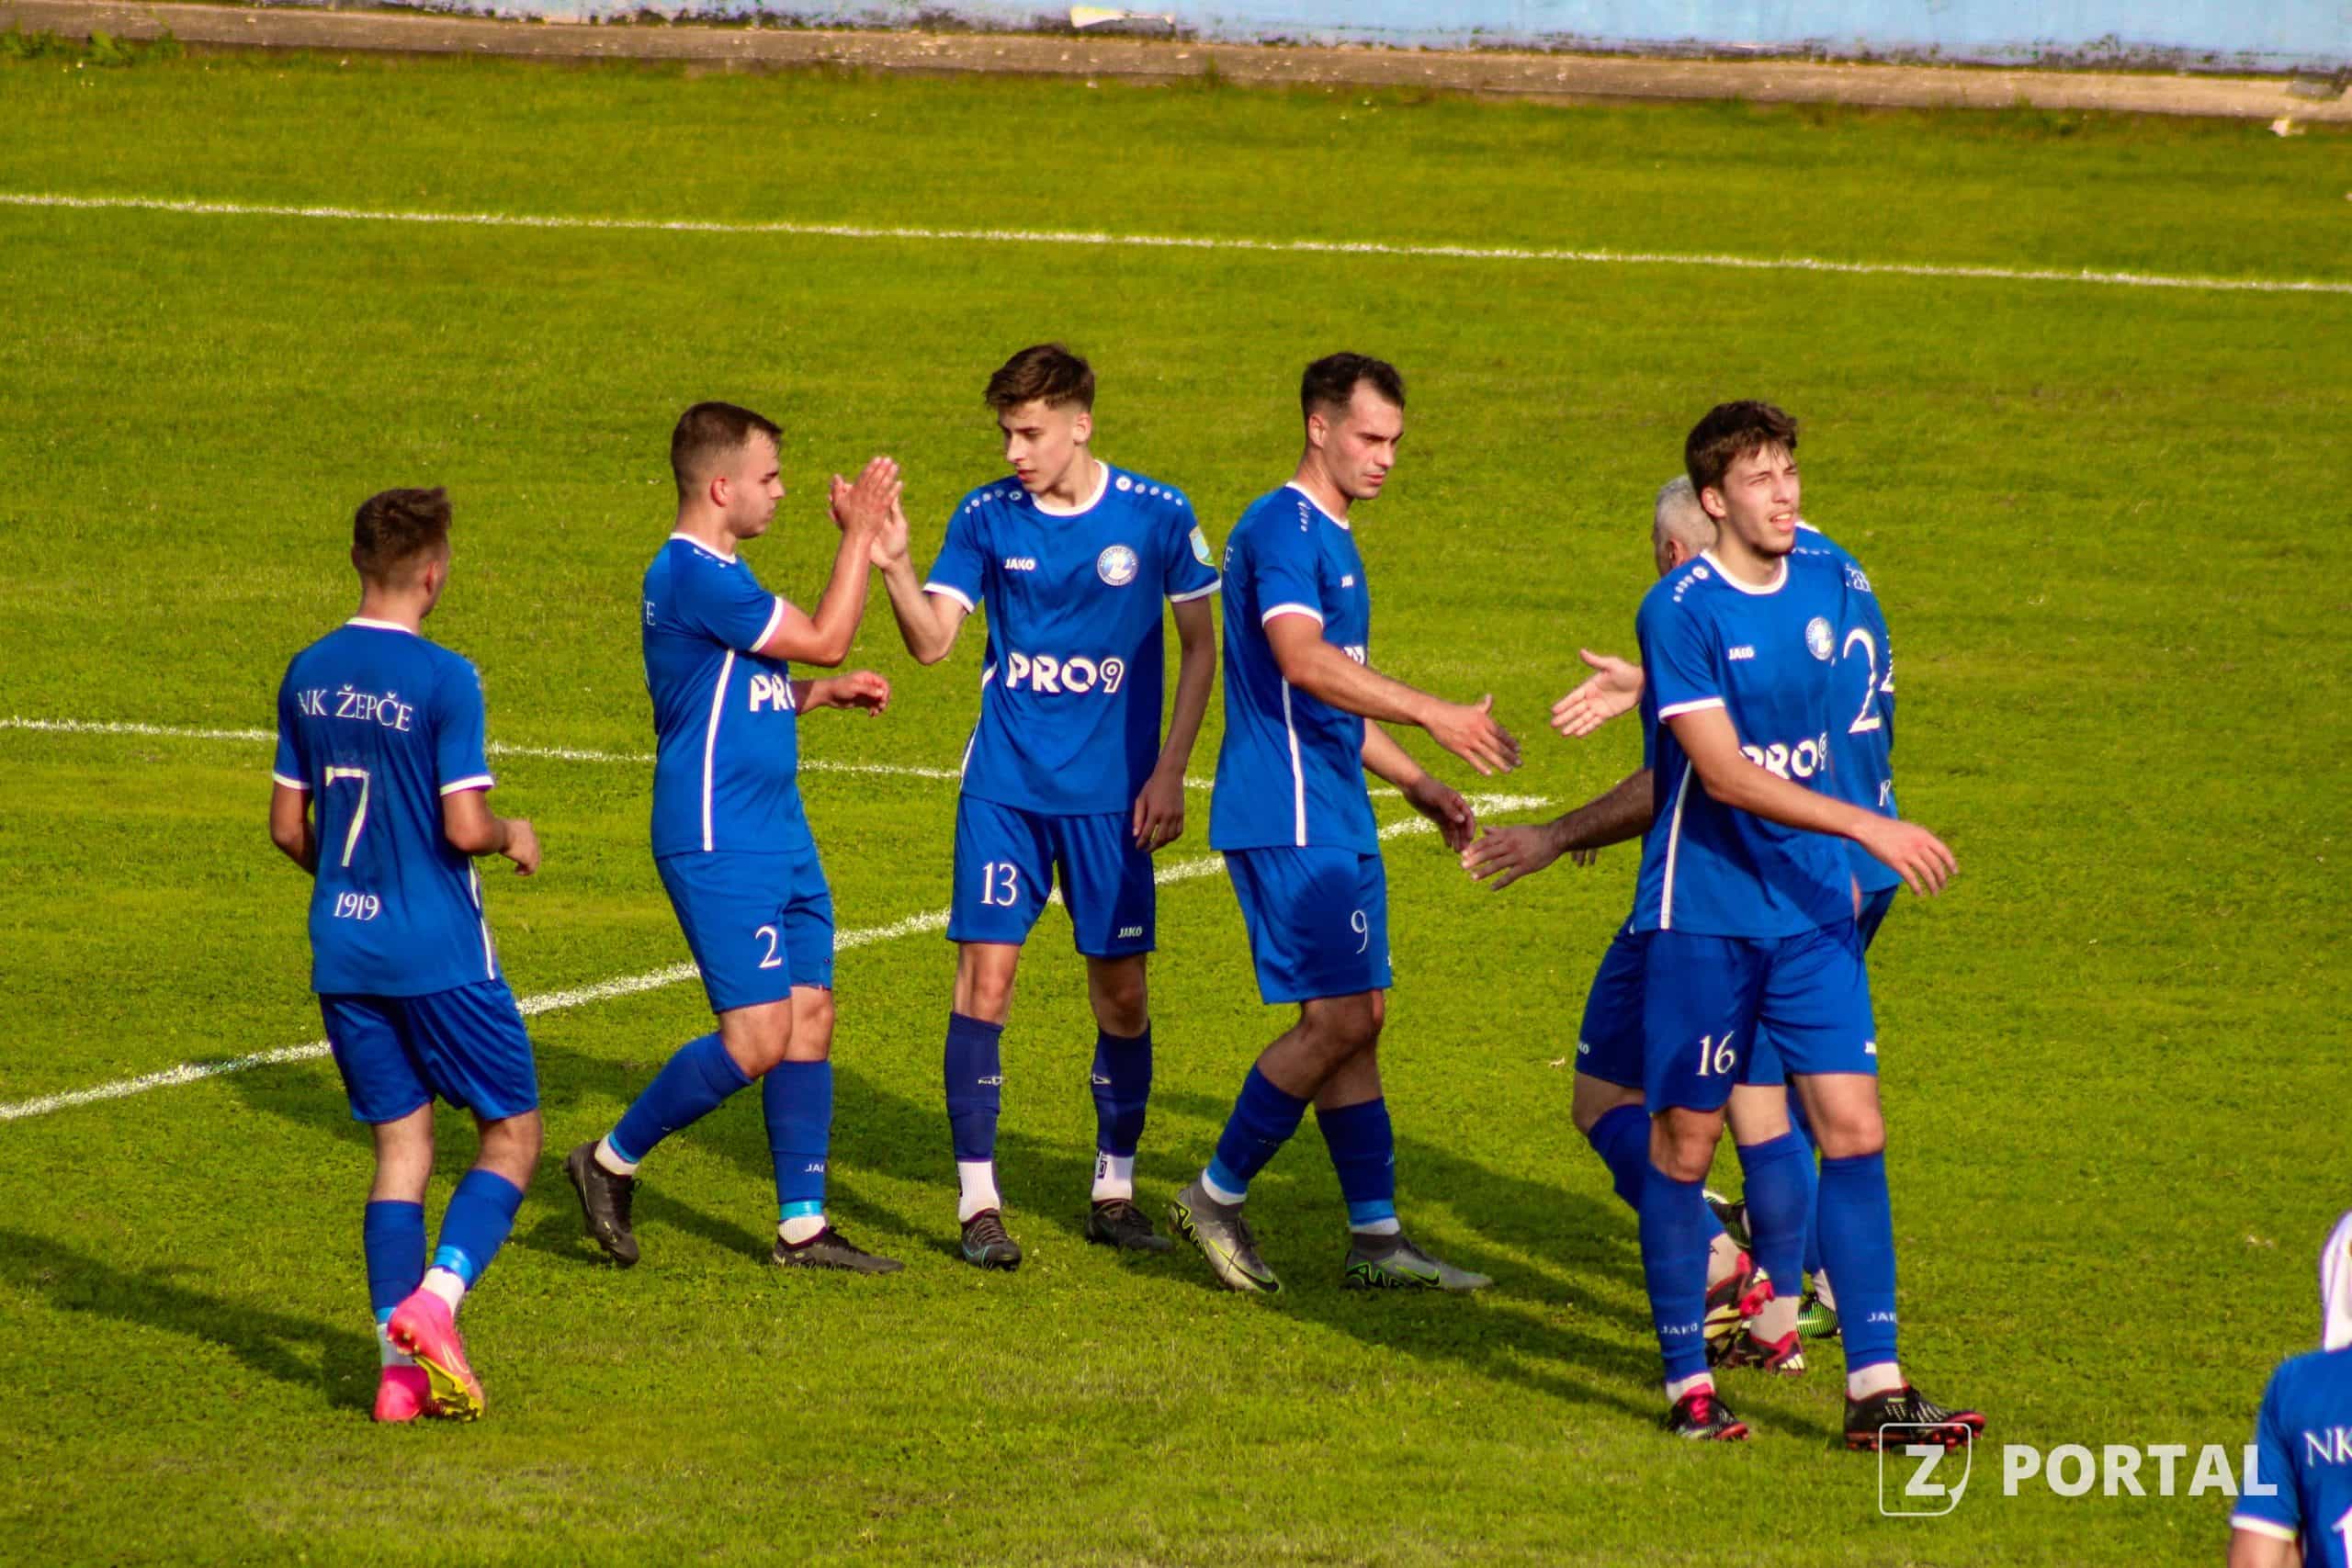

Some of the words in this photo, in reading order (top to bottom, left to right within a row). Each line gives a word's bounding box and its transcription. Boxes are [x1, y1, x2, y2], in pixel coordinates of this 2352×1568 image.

[1004, 558, 1036, 570] JAKO
[1005, 652, 1125, 694] PRO9
[297, 688, 329, 716] NK
[335, 683, 413, 732] ŽEPČE
[324, 765, 370, 868] 7
[334, 891, 380, 921] 1919
[980, 861, 1019, 907] 13
[754, 924, 783, 969] 2
[1117, 925, 1144, 940] JAKO
[1351, 909, 1369, 954] 9
[1695, 1031, 1736, 1077] 16
[2304, 1427, 2352, 1468] NK
